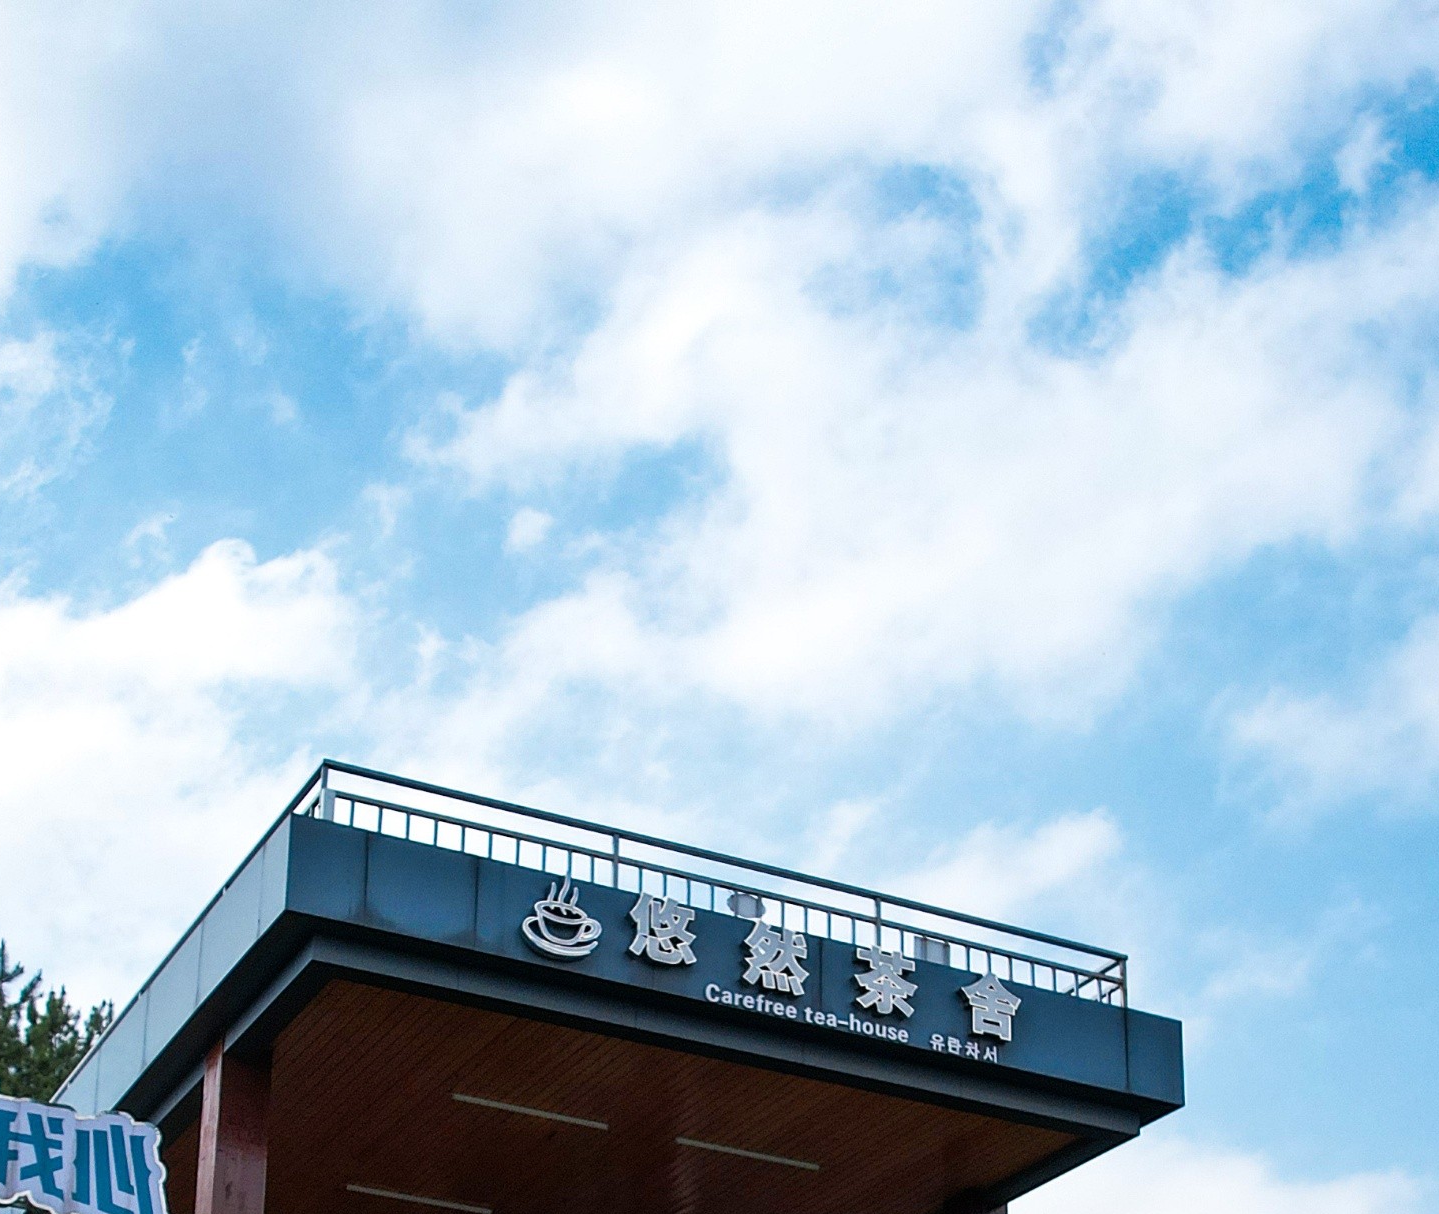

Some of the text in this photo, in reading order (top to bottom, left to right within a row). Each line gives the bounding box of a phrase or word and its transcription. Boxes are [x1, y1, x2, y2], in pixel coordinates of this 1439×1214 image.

[628, 892, 1022, 1042] 悠然茶舍
[705, 982, 910, 1044] Carefree tea-house
